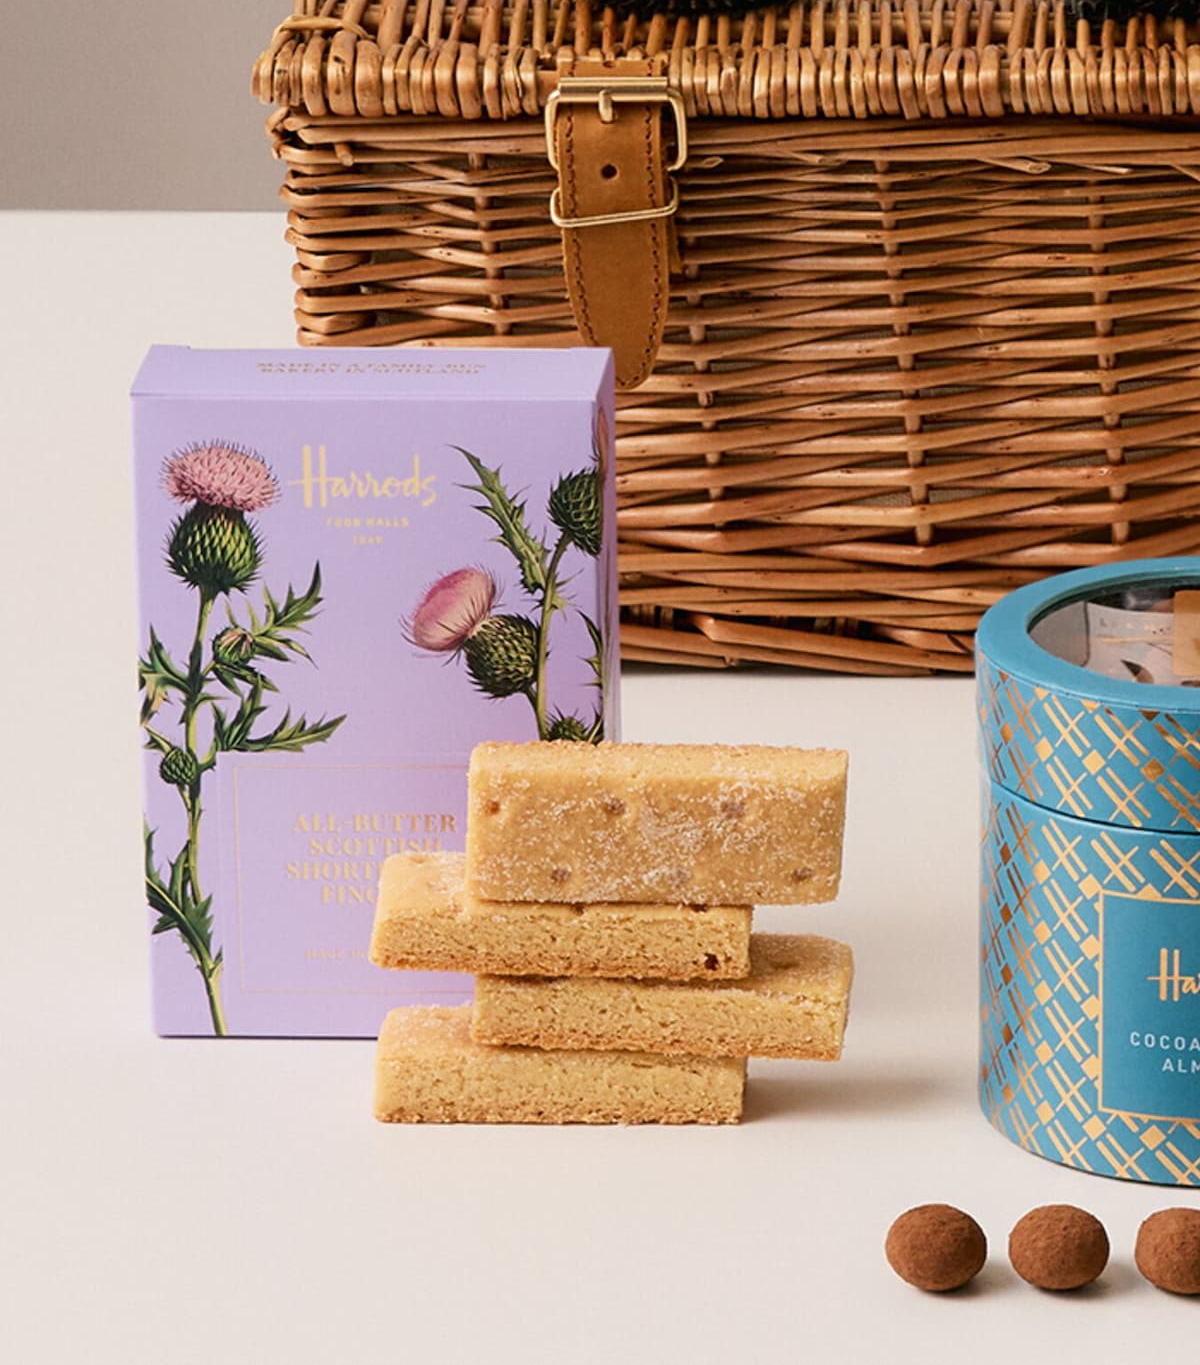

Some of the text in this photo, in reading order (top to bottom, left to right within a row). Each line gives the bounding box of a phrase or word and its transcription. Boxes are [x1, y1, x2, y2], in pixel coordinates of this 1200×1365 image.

[288, 444, 438, 509] Harrods
[293, 812, 457, 834] ALL-BUTTER
[308, 837, 442, 857] SCOTTISH
